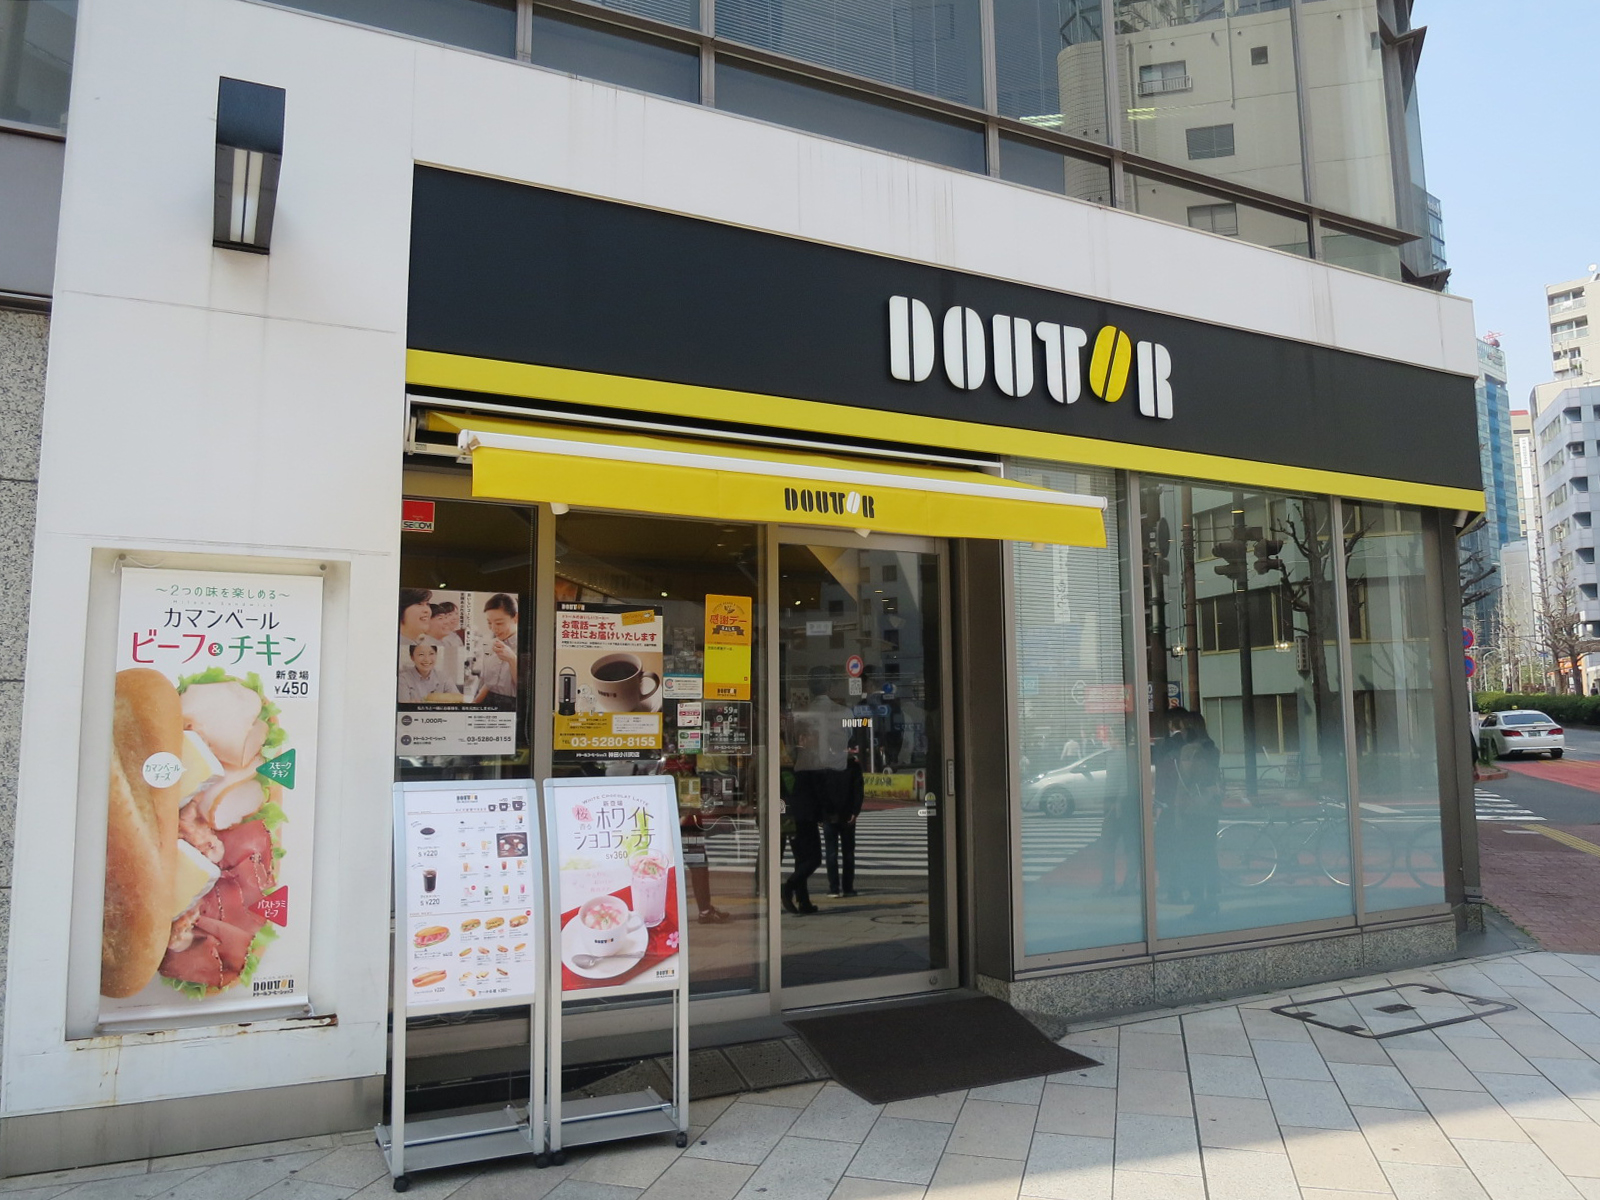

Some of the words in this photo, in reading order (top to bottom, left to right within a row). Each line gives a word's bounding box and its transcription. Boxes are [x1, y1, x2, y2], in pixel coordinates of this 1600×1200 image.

[889, 295, 1173, 420] DOUTOR
[784, 487, 875, 518] DOUTOR
[403, 521, 432, 529] SECOM
[163, 607, 280, 630] カマンベール
[561, 620, 616, 631] お電話一本で
[561, 629, 657, 642] 会社にお届けいたします
[275, 670, 309, 680] 新登場
[274, 681, 309, 695] ¥450
[842, 717, 872, 728] DOUTOR
[571, 737, 656, 747] 03-5280-8155
[144, 763, 181, 773] カマンベール
[268, 761, 292, 771] スモーク
[154, 771, 171, 781] チーズ
[271, 769, 289, 778] チキン
[576, 808, 589, 820] 桜
[596, 806, 654, 830] ホワイト
[574, 829, 656, 850] ショコラ・ラテ
[257, 899, 287, 909] パストラミ
[264, 907, 279, 917] ビーフ
[253, 979, 294, 992] DOUTOR
